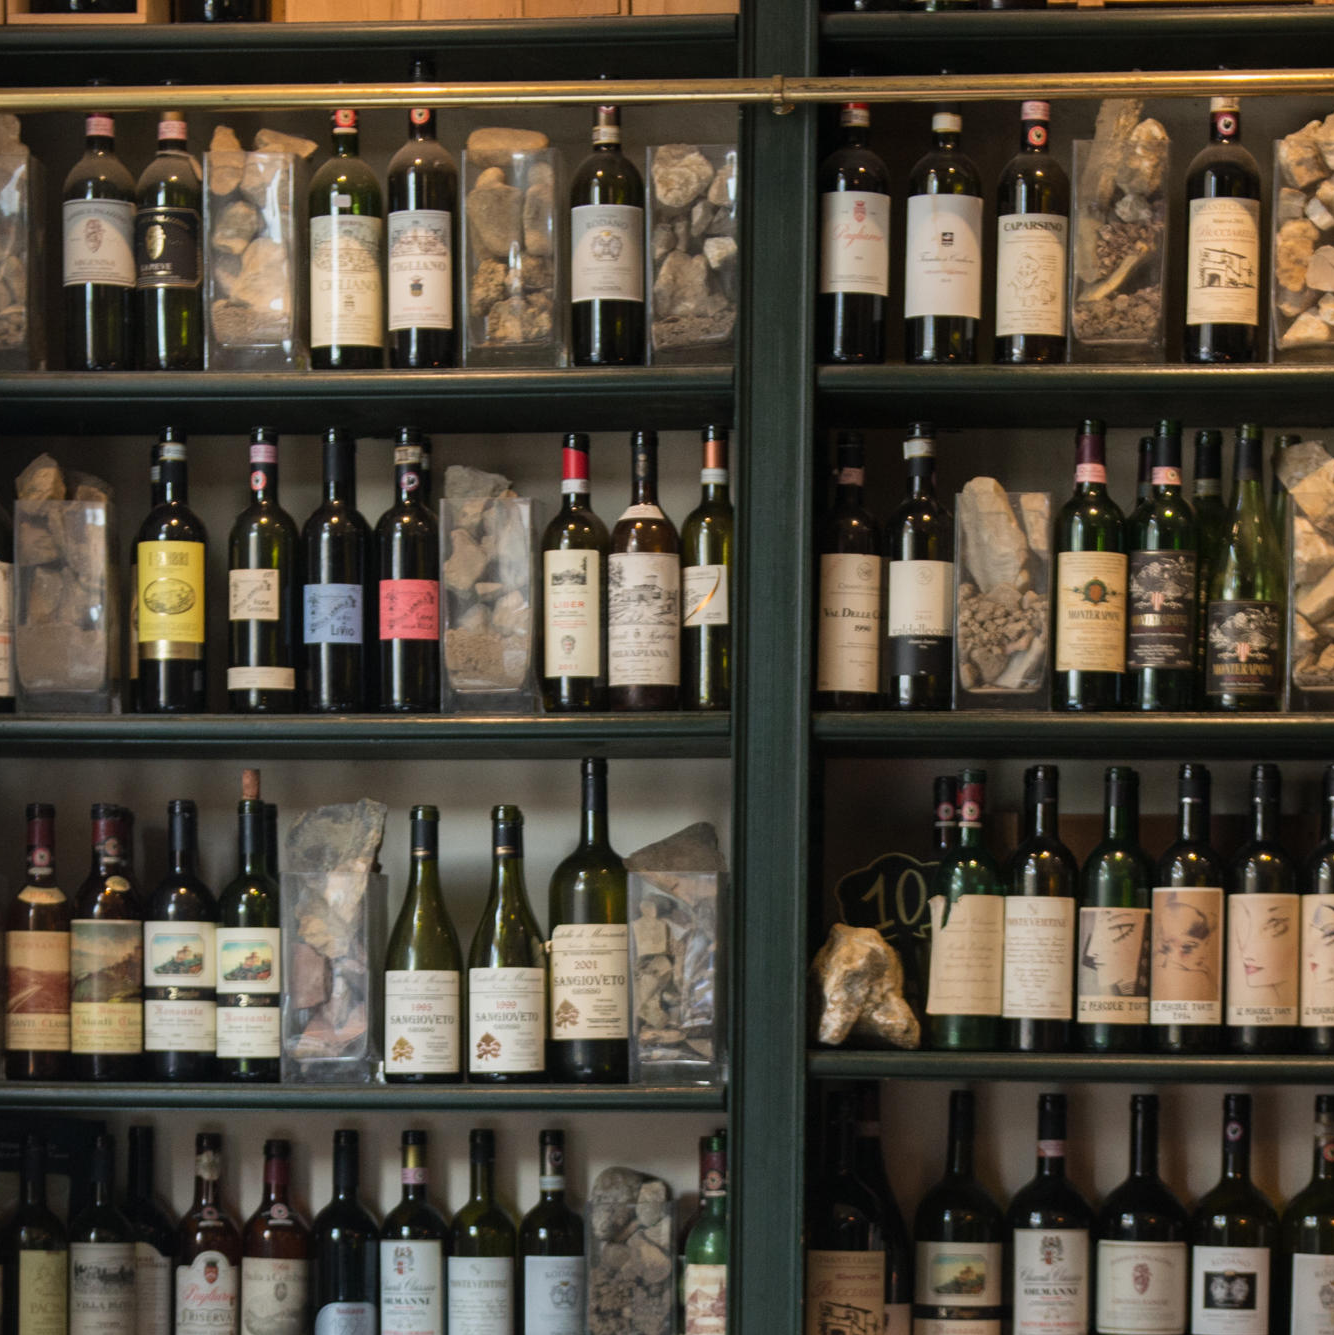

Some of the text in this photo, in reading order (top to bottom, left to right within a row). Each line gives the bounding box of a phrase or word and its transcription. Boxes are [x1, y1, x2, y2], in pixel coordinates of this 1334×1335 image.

[586, 218, 628, 231] RODANO
[1003, 221, 1063, 232] CAPARSINO
[391, 260, 447, 273] CIGLIANO
[553, 600, 585, 609] LIBER
[824, 608, 870, 620] VAL DELLE
[610, 648, 670, 659] SELVAPIANA
[573, 960, 598, 970] 2001
[553, 975, 626, 987] SANGIOVETO
[153, 1005, 203, 1018] Monsanto
[1090, 1001, 1123, 1011] PERGOLE
[222, 1011, 274, 1025] Monsanto
[389, 1013, 455, 1026] SANGIOVETO
[474, 1011, 540, 1023] SANGIOVETO
[407, 1026, 436, 1034] GROSSO
[492, 1023, 521, 1031] GROSSO
[1023, 1286, 1079, 1297] ORMANNI
[188, 1311, 233, 1322] RISERVA
